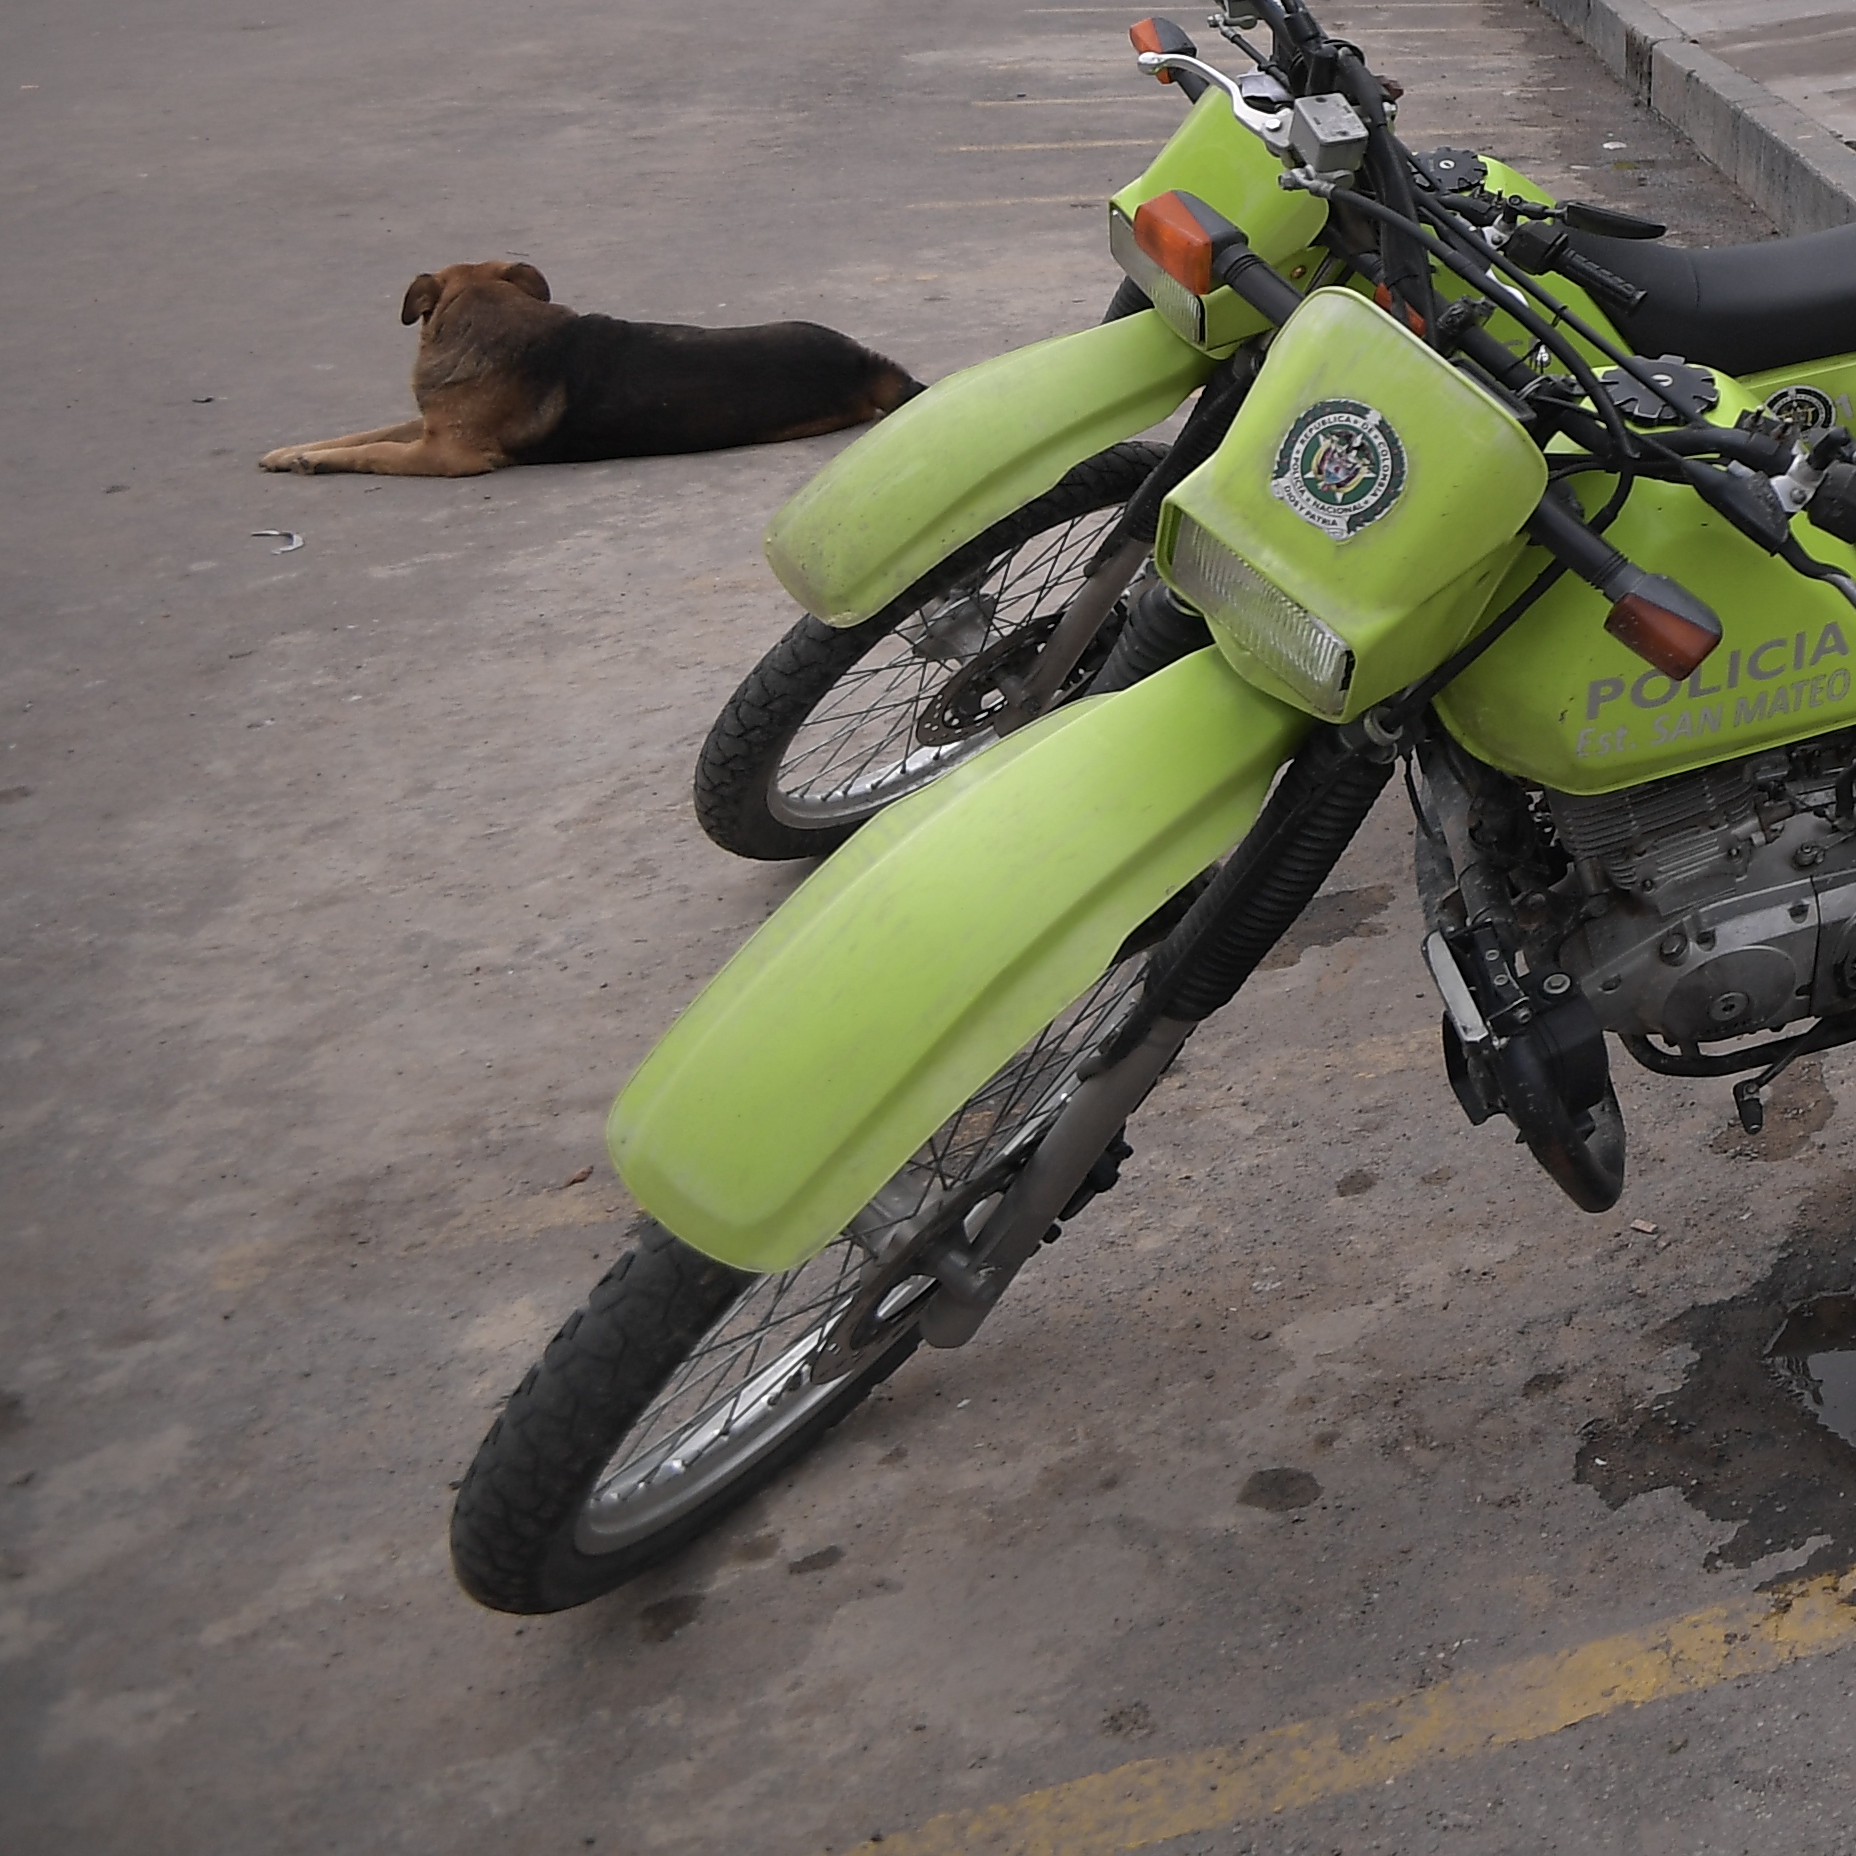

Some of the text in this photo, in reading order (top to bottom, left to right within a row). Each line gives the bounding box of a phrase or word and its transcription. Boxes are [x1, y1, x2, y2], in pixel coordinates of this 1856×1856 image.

[1291, 457, 1366, 515] POLICIA NACIONAL
[1299, 415, 1391, 498] REPUBLICA DE COLOMBIA
[1283, 485, 1300, 507] DIOS
[1304, 507, 1339, 527] PATRIA
[1586, 621, 1850, 720] POLICIA
[1575, 668, 1851, 758] Est. SAN MATEO
